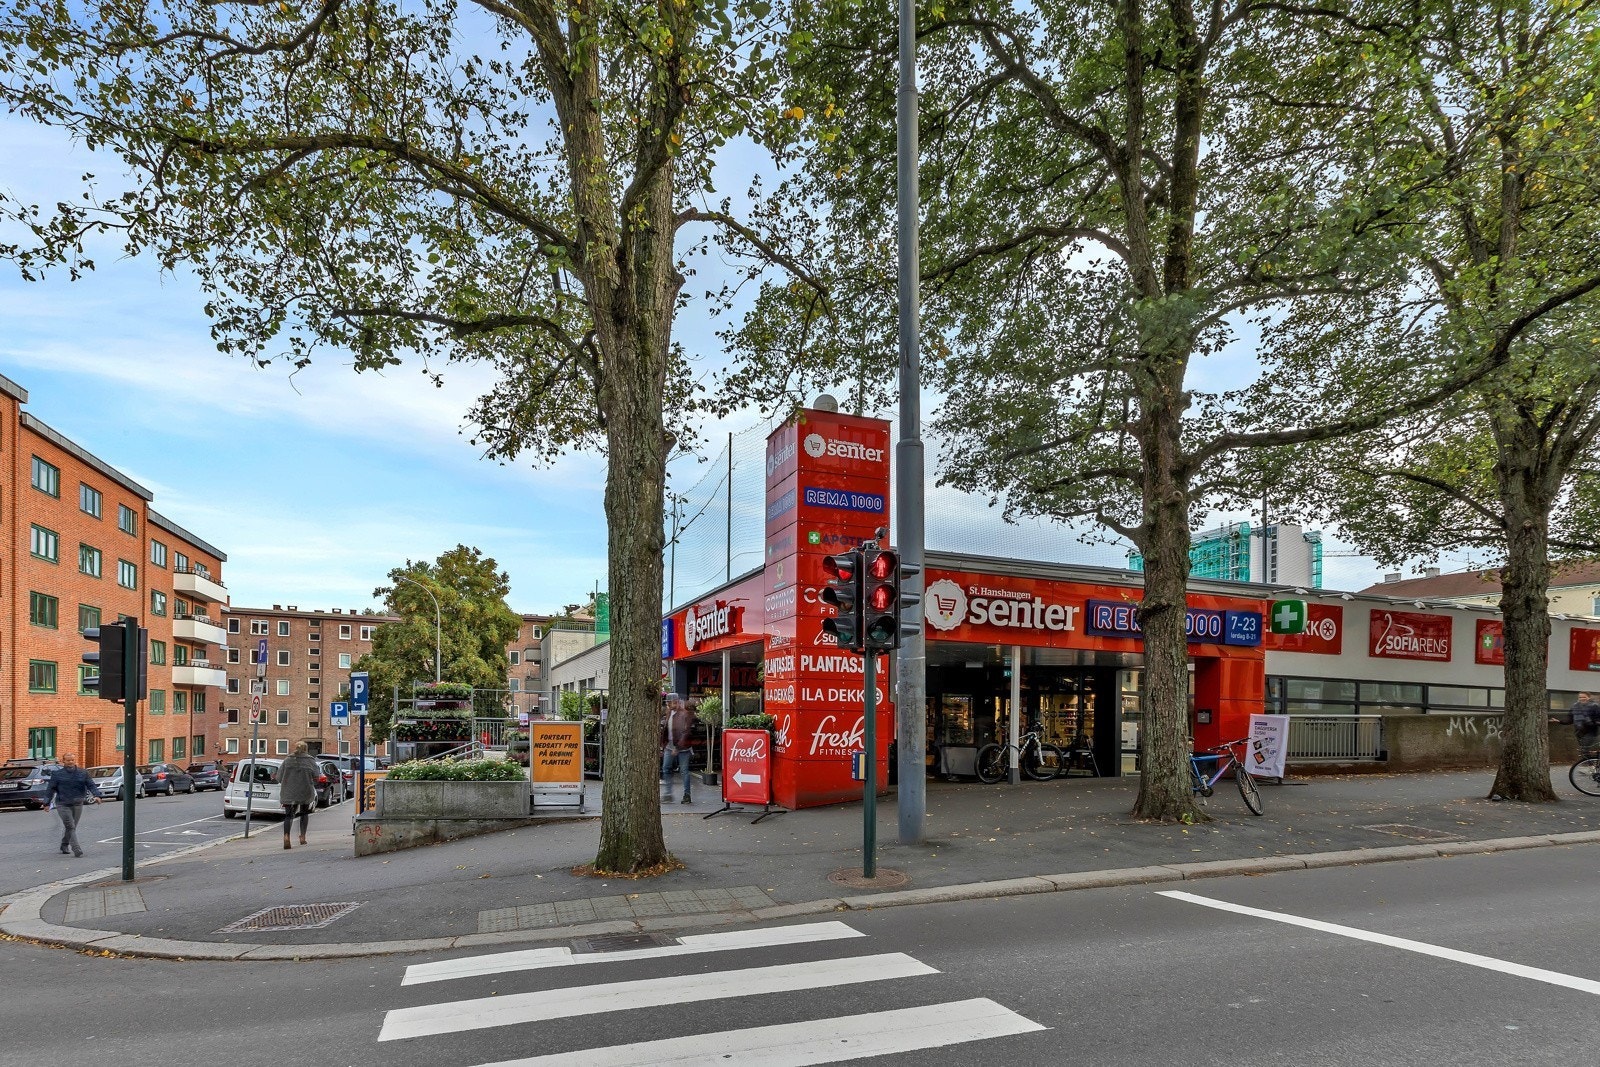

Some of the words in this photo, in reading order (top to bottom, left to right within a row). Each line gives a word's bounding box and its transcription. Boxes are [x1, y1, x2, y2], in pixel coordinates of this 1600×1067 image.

[774, 442, 796, 469] senter
[827, 443, 884, 462] senter
[807, 490, 848, 506] REMA
[851, 495, 882, 510] 1000
[822, 534, 864, 547] APOTE
[765, 589, 794, 612] COMINO
[969, 587, 979, 595] St.
[981, 588, 1031, 600] Hanshaugen
[696, 605, 730, 641] senter
[970, 597, 1080, 630] senter
[1231, 616, 1256, 631] 7-23
[259, 642, 266, 661] P
[1386, 635, 1448, 654] SOFIARENS
[801, 655, 885, 673] PLANTASJN.
[354, 680, 365, 699] P
[802, 688, 825, 701] ILA
[334, 704, 344, 716] P
[810, 715, 865, 756] fresh
[539, 749, 547, 757] PÅ
[730, 738, 767, 761] fresh
